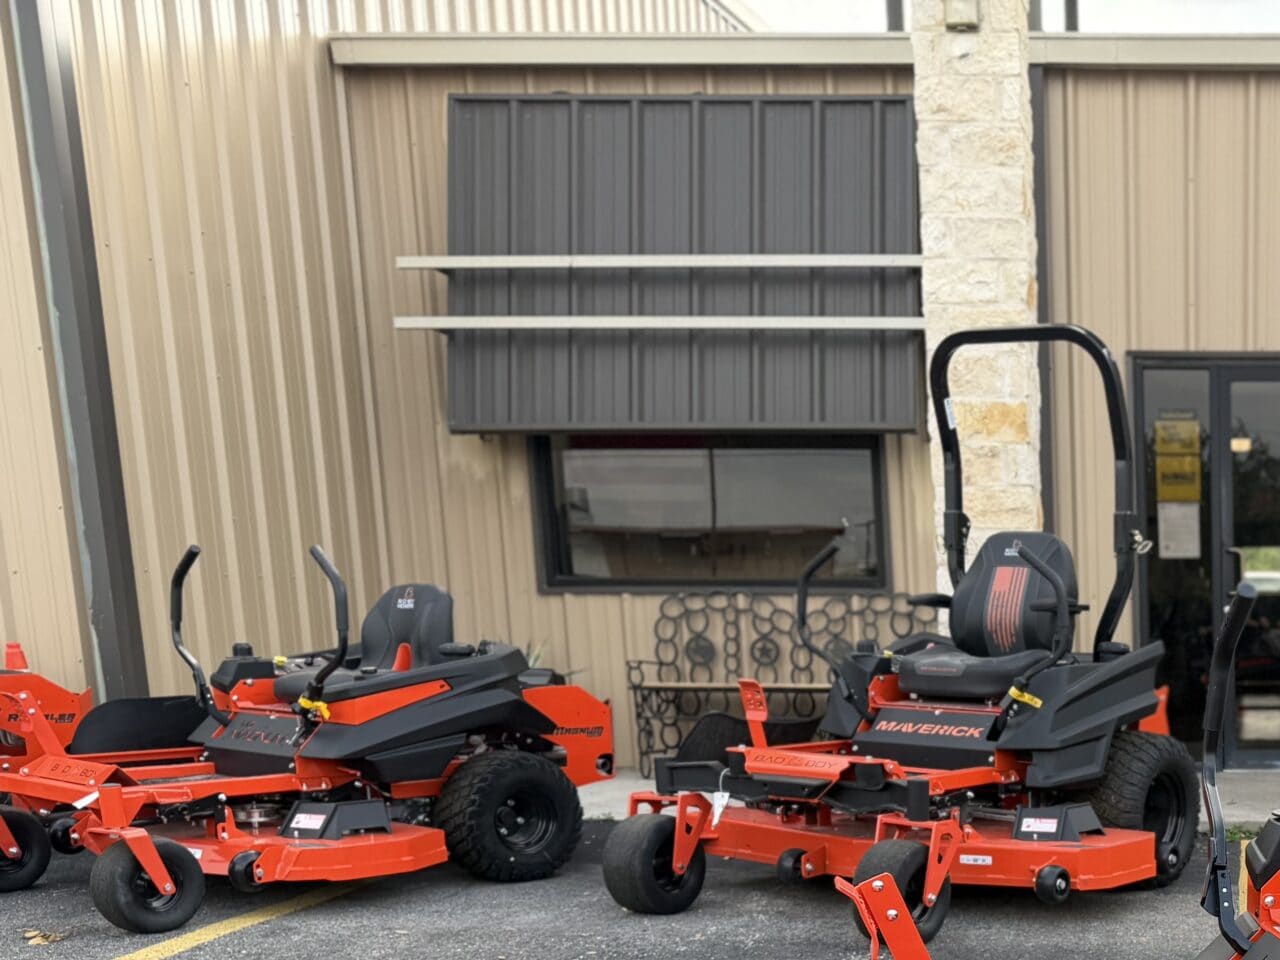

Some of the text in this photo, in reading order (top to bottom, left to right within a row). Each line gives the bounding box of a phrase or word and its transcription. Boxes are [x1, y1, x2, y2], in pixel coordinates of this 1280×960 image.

[876, 721, 984, 738] MAVERICK
[753, 754, 840, 769] BAD BOY
